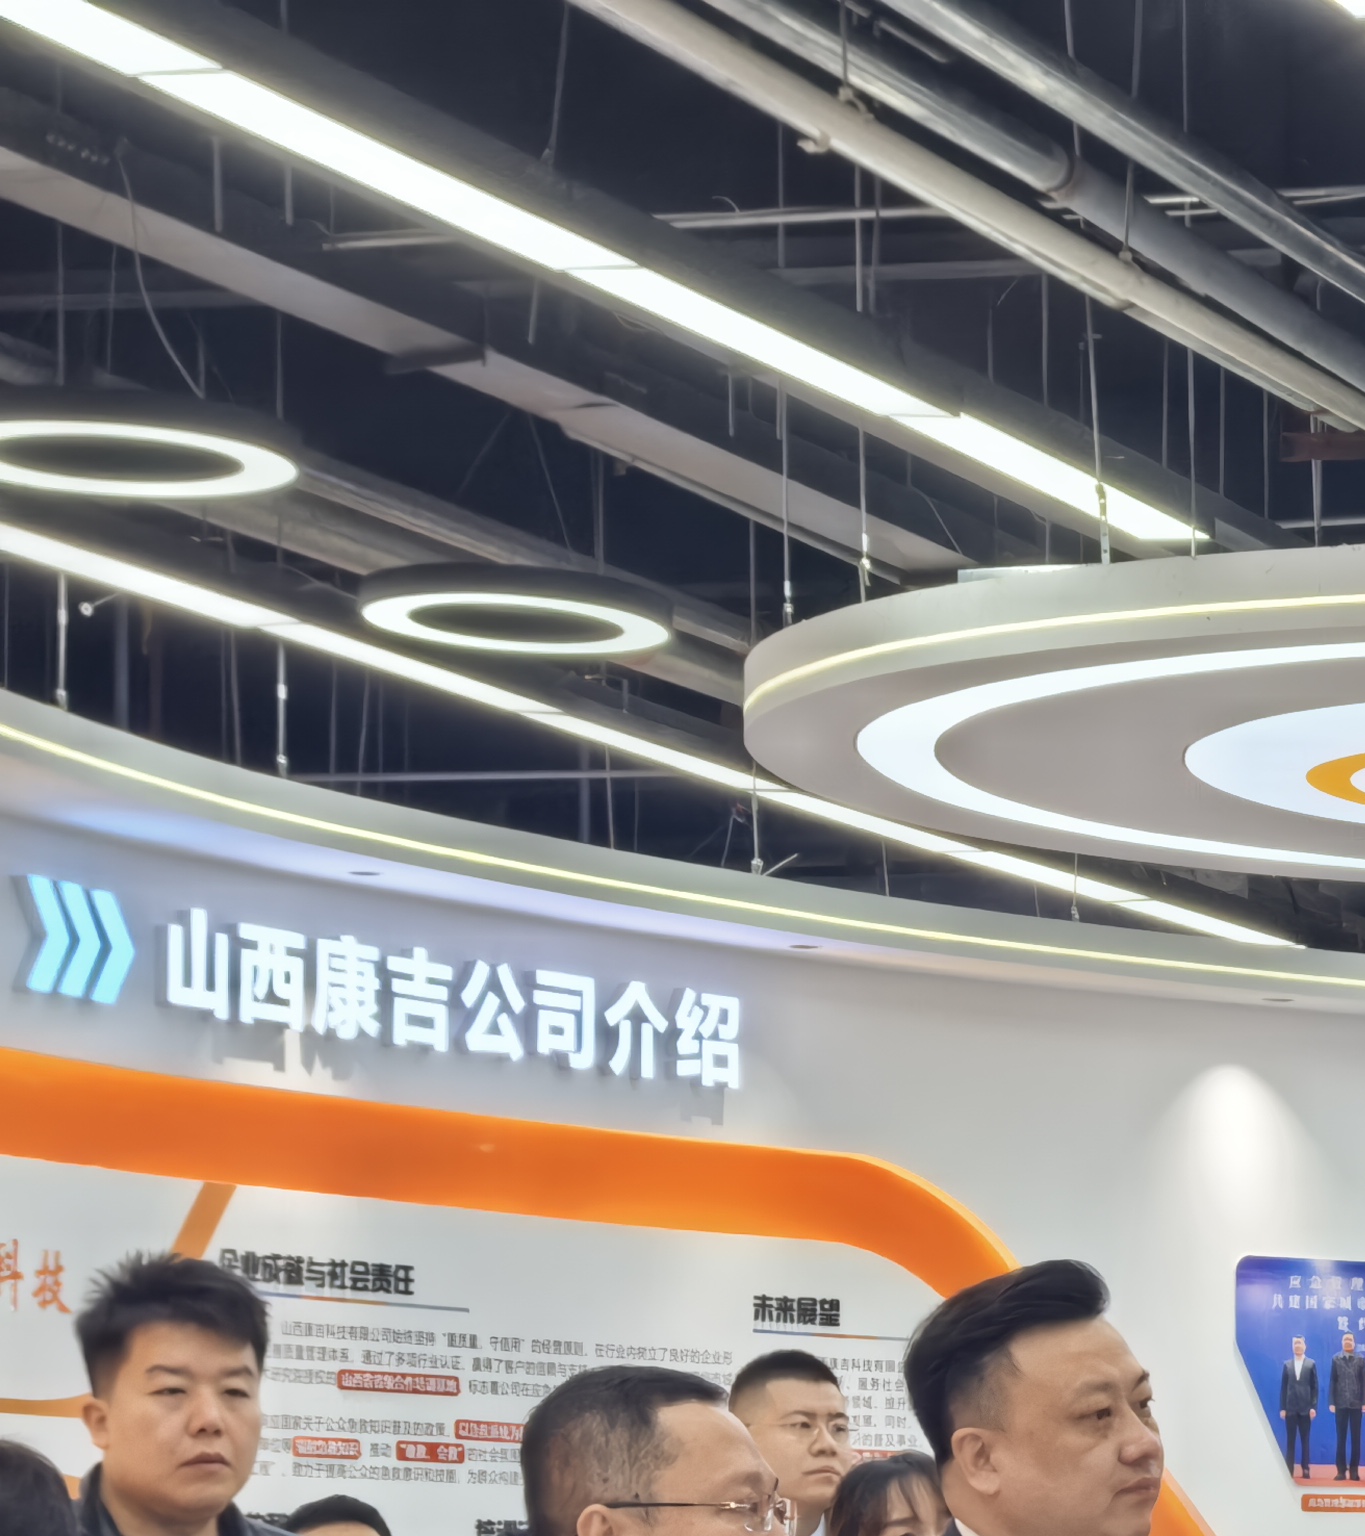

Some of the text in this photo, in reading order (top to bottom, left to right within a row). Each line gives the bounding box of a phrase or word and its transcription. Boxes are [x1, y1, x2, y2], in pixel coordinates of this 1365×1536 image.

[165, 896, 741, 1090] 山西康吉公司介绍
[753, 1294, 841, 1328] 未来展望
